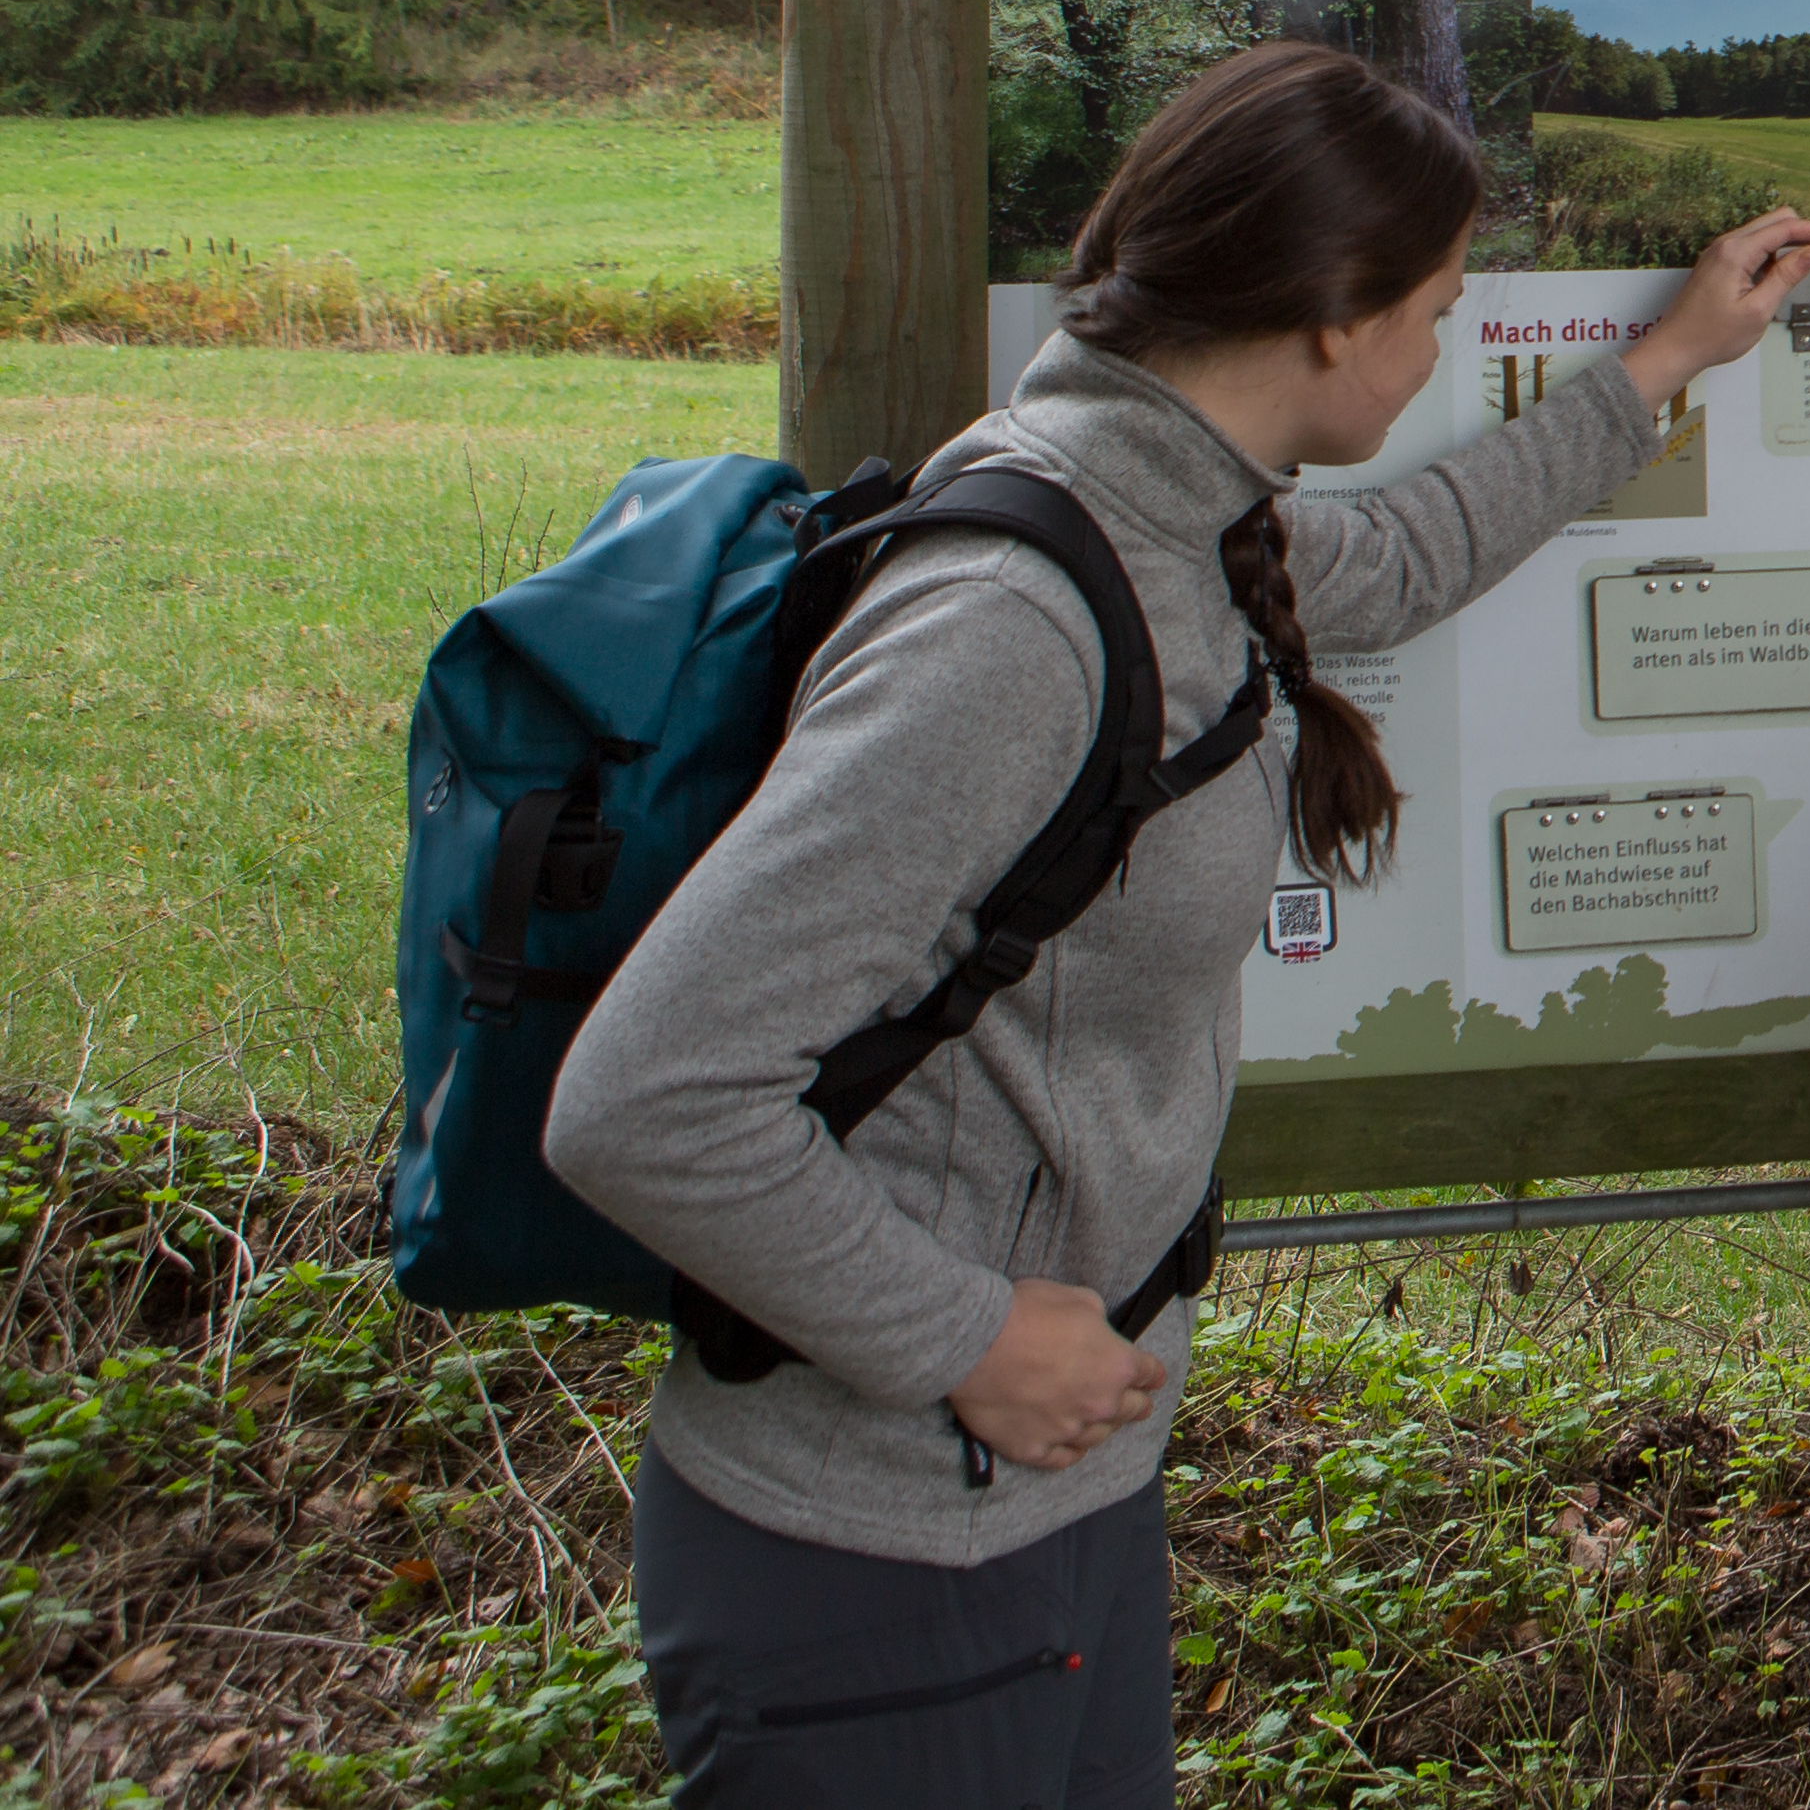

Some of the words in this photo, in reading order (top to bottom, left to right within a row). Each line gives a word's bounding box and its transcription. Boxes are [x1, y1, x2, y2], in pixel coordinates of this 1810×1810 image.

[1481, 320, 1552, 343] Mach
[1562, 318, 1617, 341] dich
[1300, 486, 1385, 499] interessante
[1632, 623, 1698, 644] Warum
[1704, 621, 1757, 640] leben
[1762, 619, 1780, 636] in
[1316, 656, 1342, 669] Das
[1345, 654, 1395, 668] Wasser
[1633, 651, 1682, 669] arten
[1688, 649, 1715, 666] als
[1721, 647, 1744, 665] im
[1347, 672, 1379, 687] reich
[1384, 673, 1400, 685] an
[1528, 844, 1609, 863] Welchen
[1616, 839, 1690, 857] Einfluss
[1697, 834, 1727, 852] hat
[1530, 871, 1559, 889] die
[1566, 864, 1674, 885] Mahdwiese
[1680, 860, 1711, 878] auf
[1531, 897, 1565, 914] den
[1572, 885, 1719, 911] Bachabschnitt?
